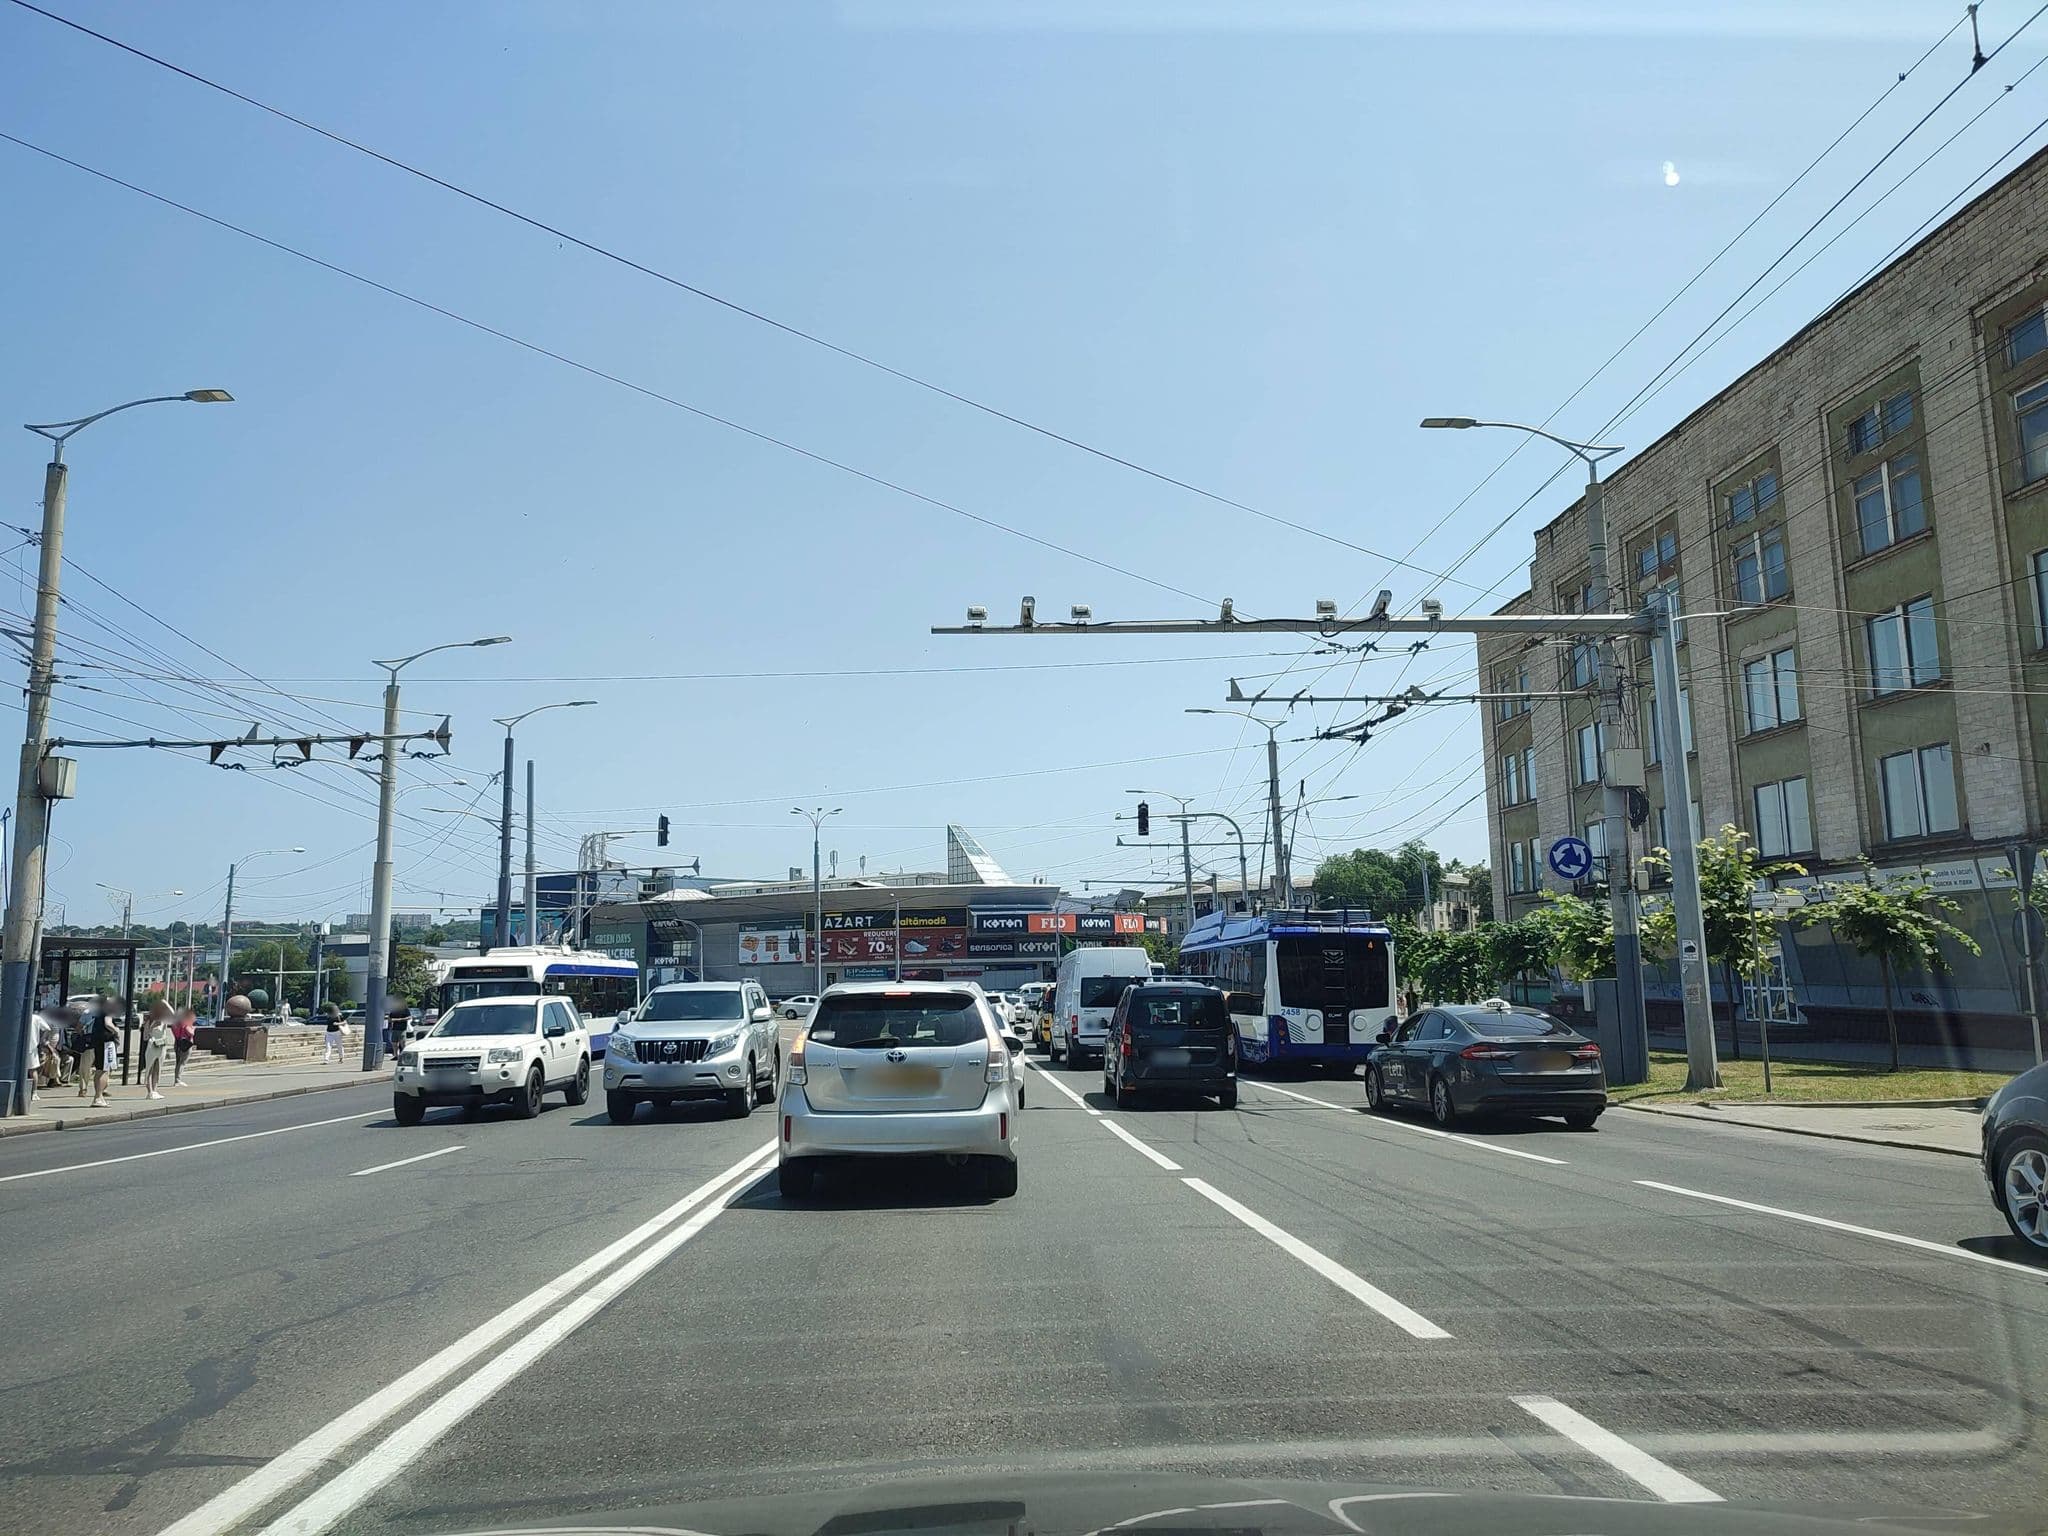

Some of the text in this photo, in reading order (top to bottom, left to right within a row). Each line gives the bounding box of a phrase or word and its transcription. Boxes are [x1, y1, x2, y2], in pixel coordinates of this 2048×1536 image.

[824, 916, 873, 928] AZART
[983, 919, 1023, 929] KOTON
[1041, 917, 1066, 929] FLO
[1081, 918, 1111, 928] KOTON
[1122, 918, 1138, 929] FLO
[594, 932, 632, 945] GREEN DAYS
[868, 941, 894, 953] 70%
[969, 942, 1013, 952] sensorica
[1018, 942, 1057, 952] KOTON
[1280, 1008, 1301, 1016] 2458
